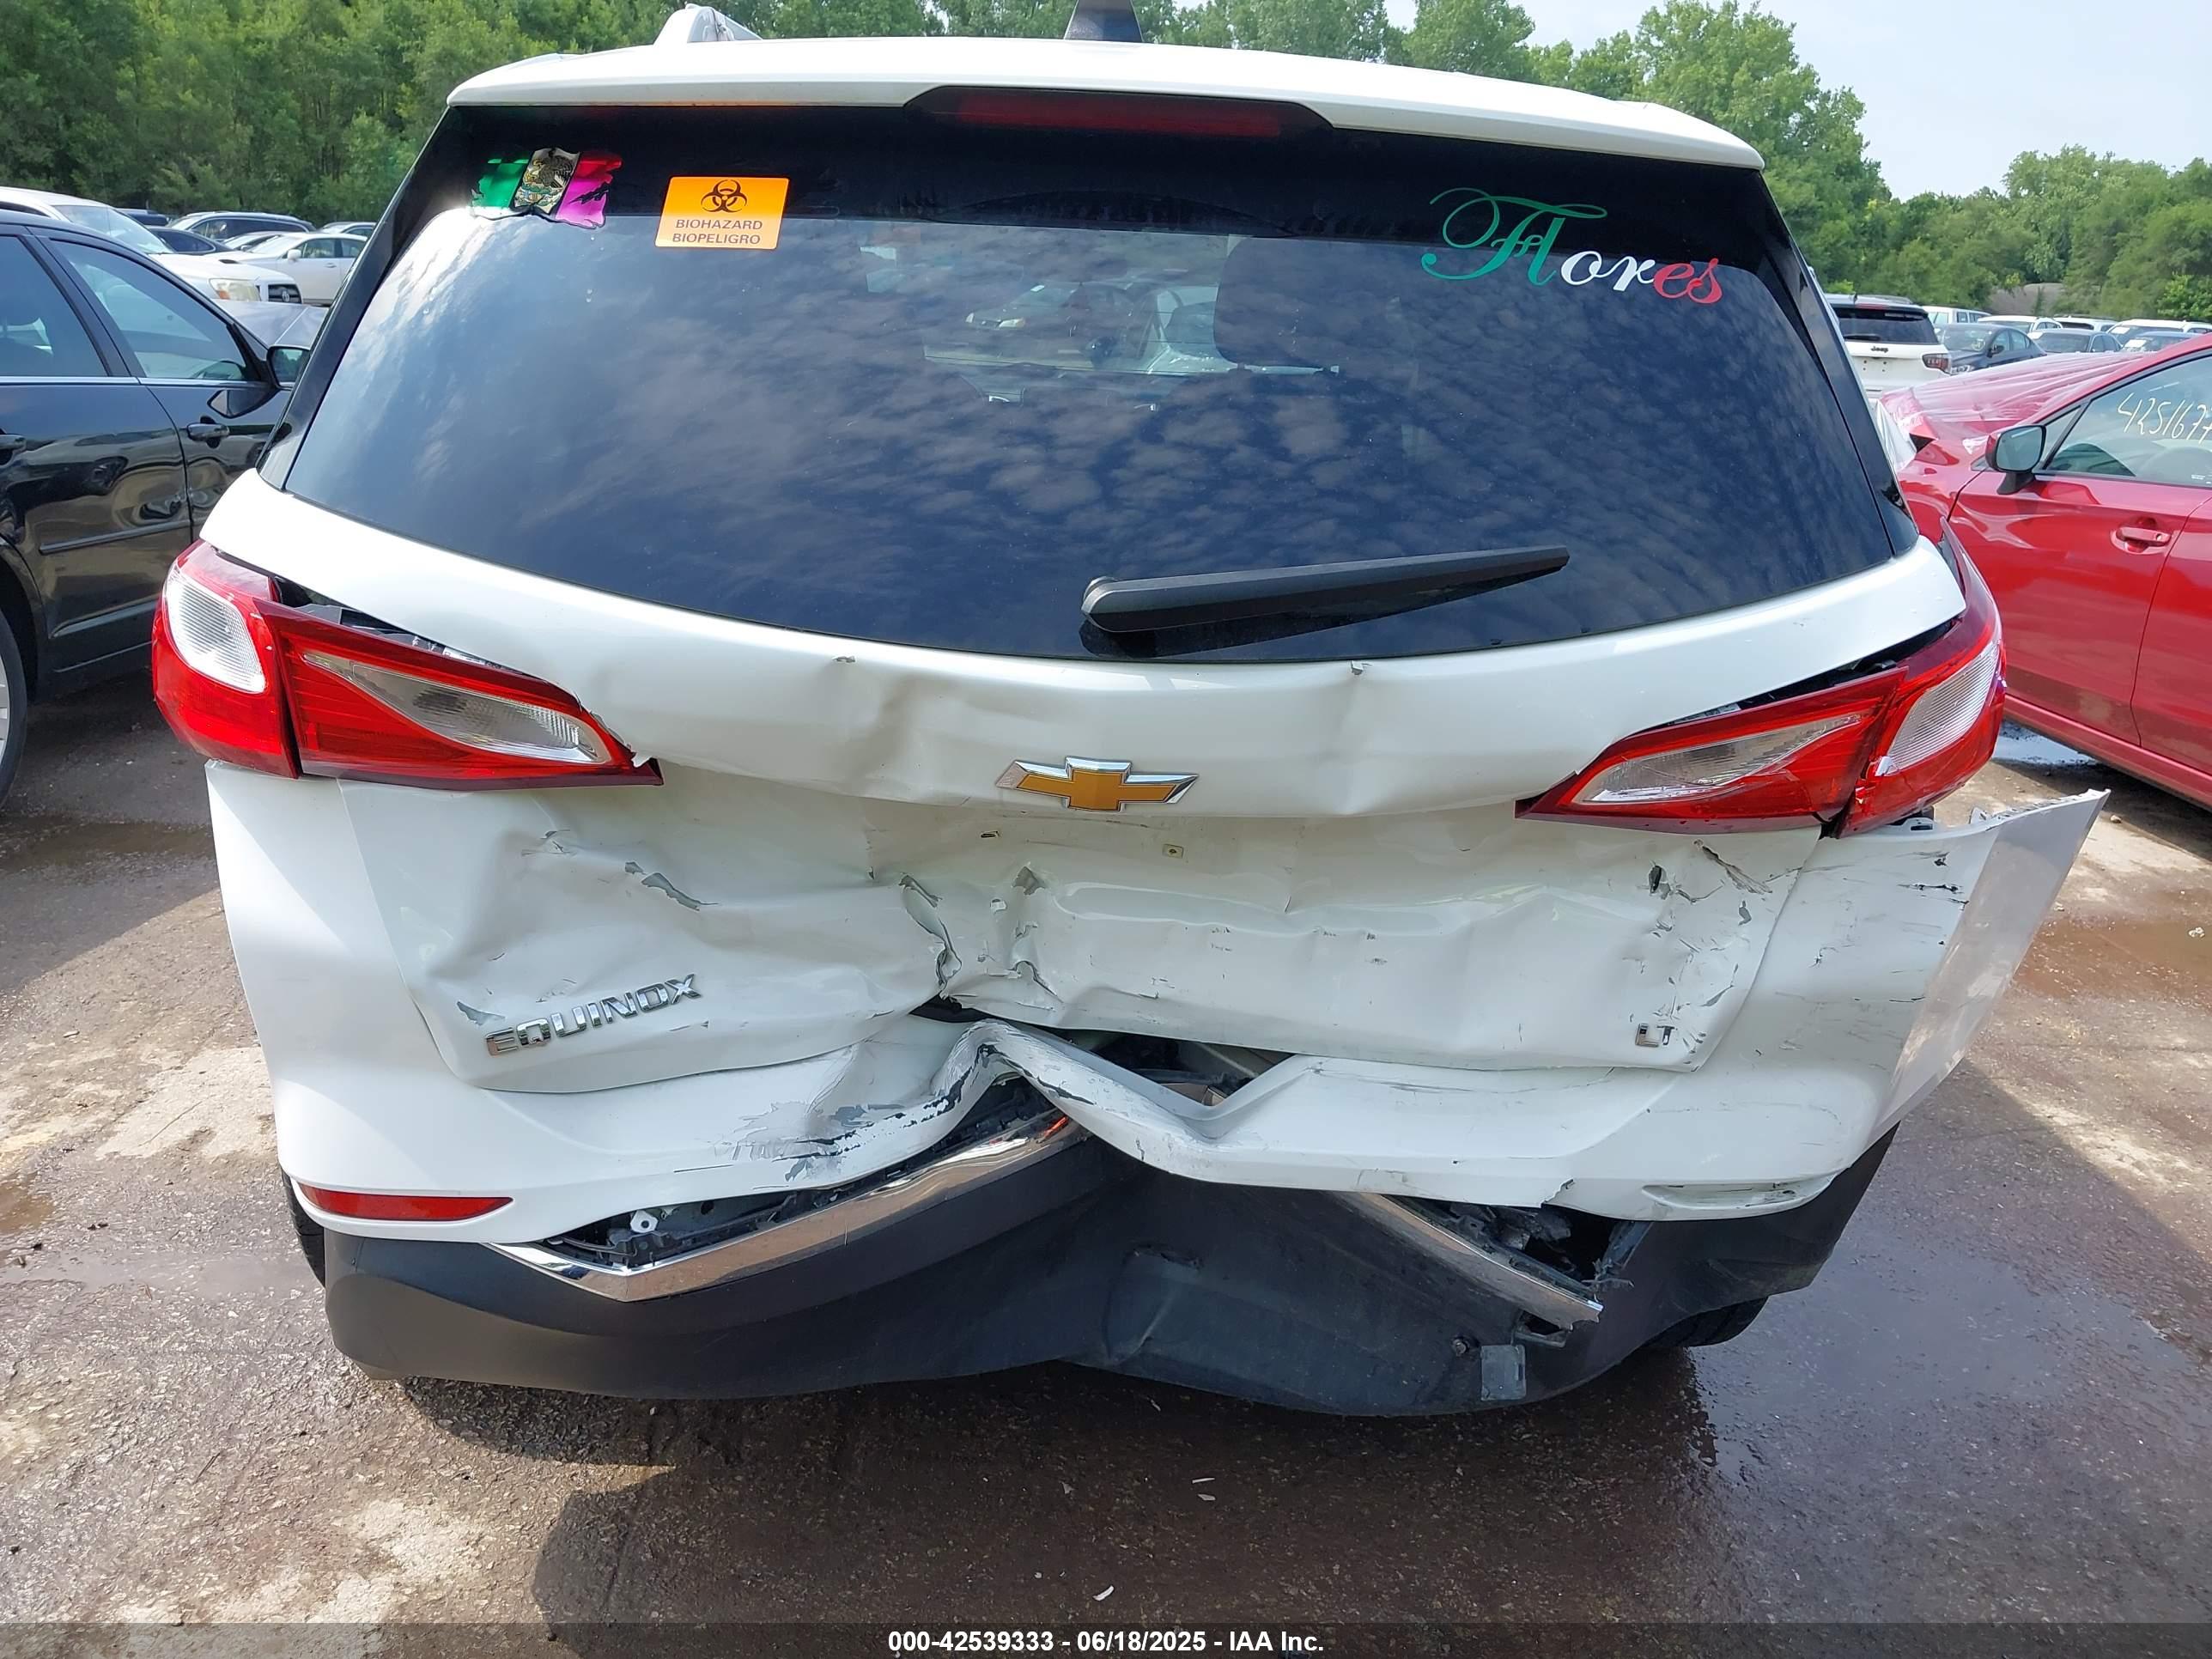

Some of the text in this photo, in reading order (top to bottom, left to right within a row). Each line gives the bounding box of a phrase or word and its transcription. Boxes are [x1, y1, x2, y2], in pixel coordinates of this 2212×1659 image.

[675, 219, 763, 230] BIOHAZARD
[672, 233, 761, 245] BIOPELIGRO
[1421, 187, 1723, 304] Flores
[485, 973, 701, 1057] EQUINOX
[1635, 1023, 1675, 1048] LT
